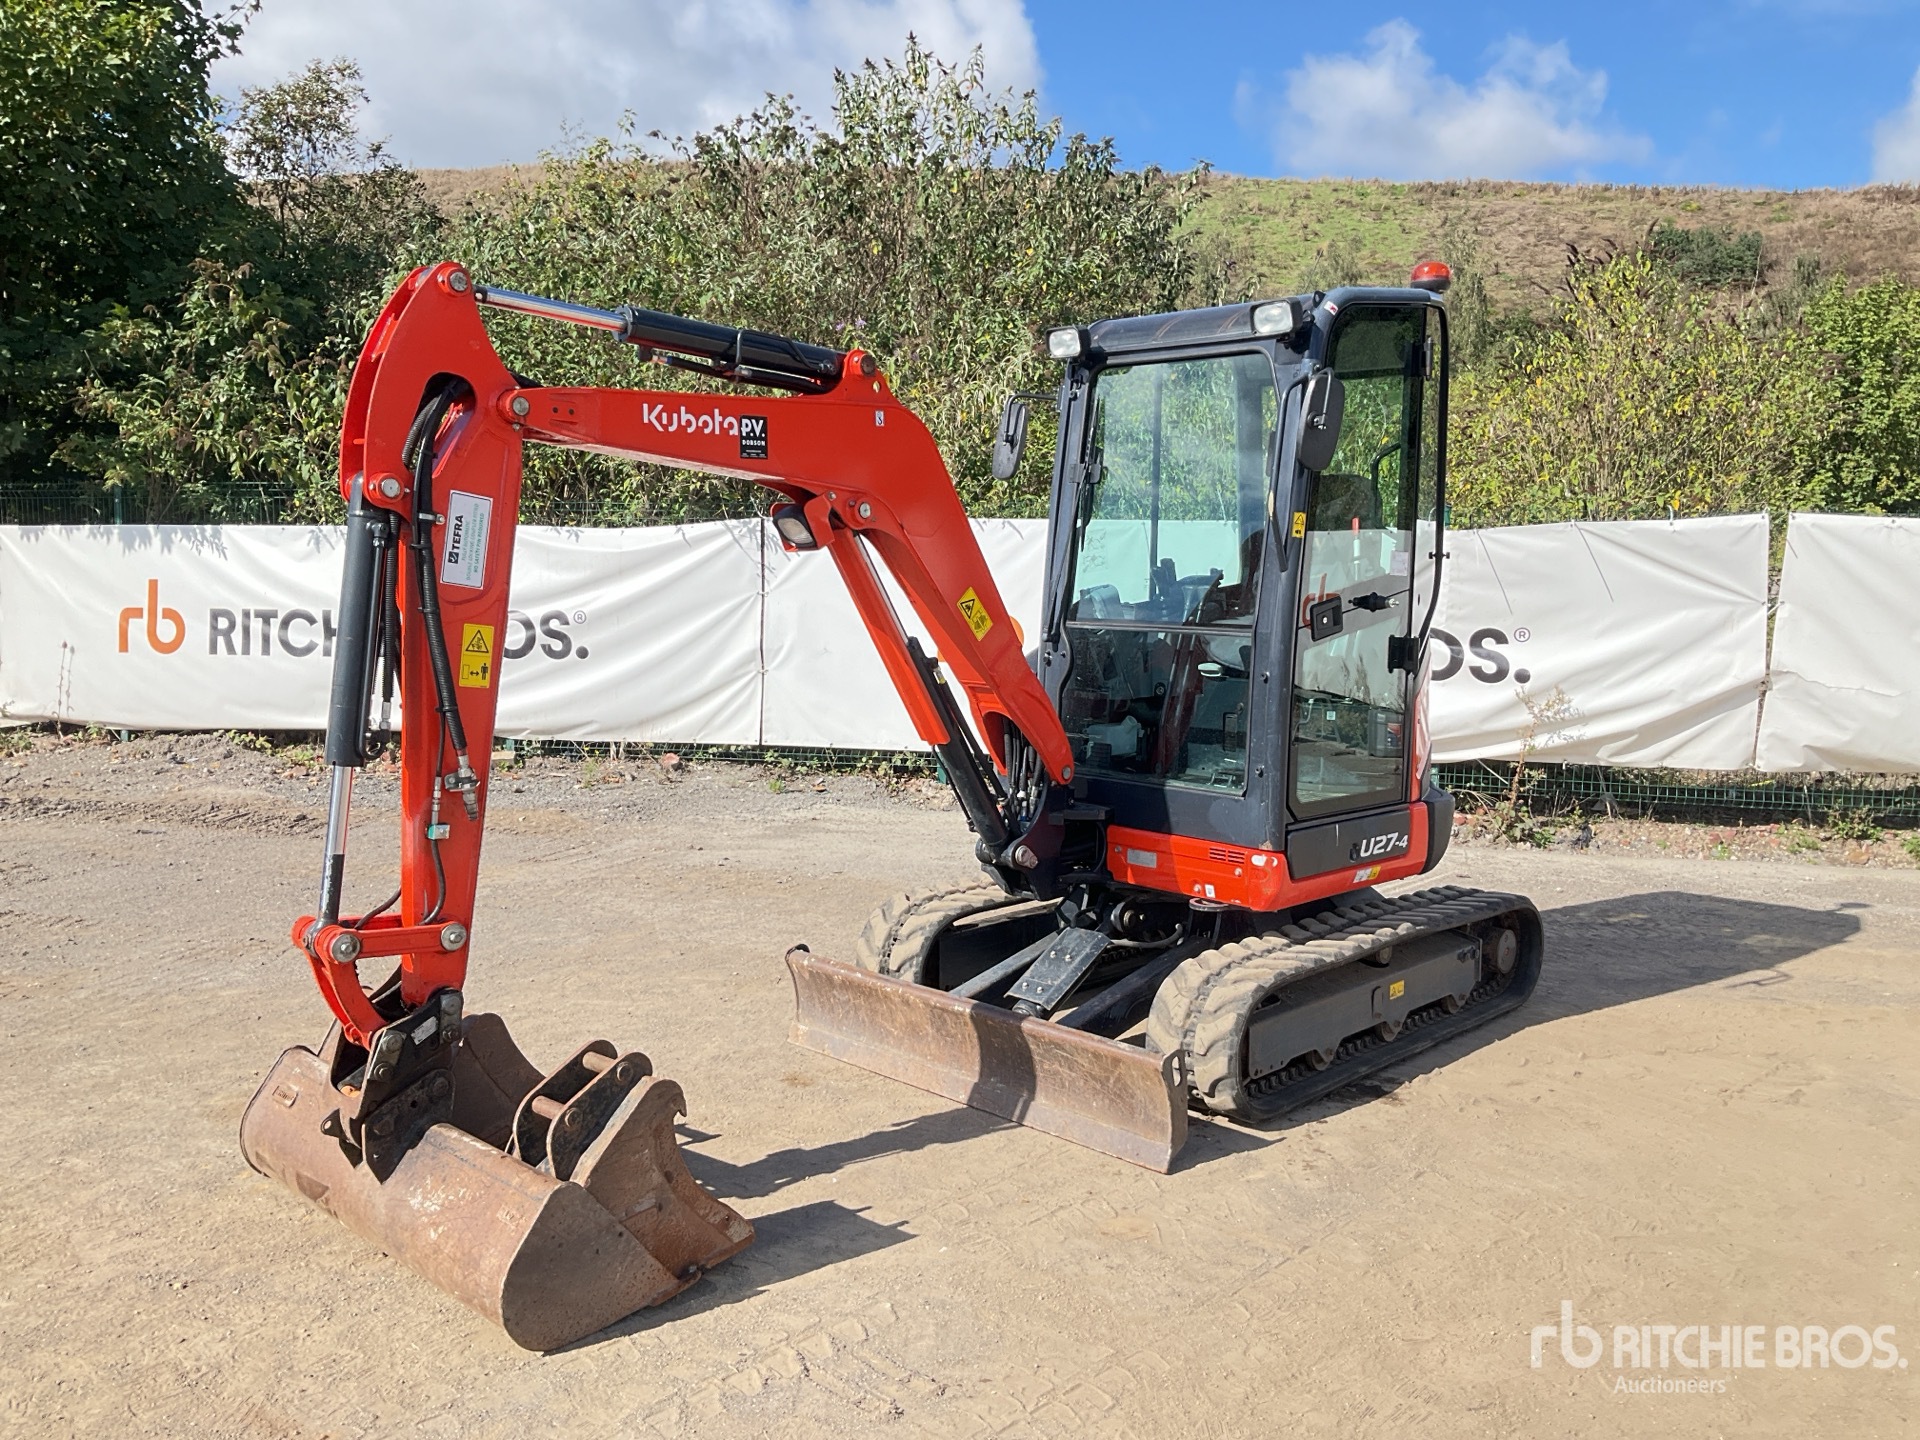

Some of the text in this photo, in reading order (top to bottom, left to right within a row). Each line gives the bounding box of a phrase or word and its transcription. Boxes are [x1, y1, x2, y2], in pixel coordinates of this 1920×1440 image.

[642, 403, 738, 436] Kubota
[451, 515, 463, 550] TEFRA
[1360, 832, 1408, 857] U27-4
